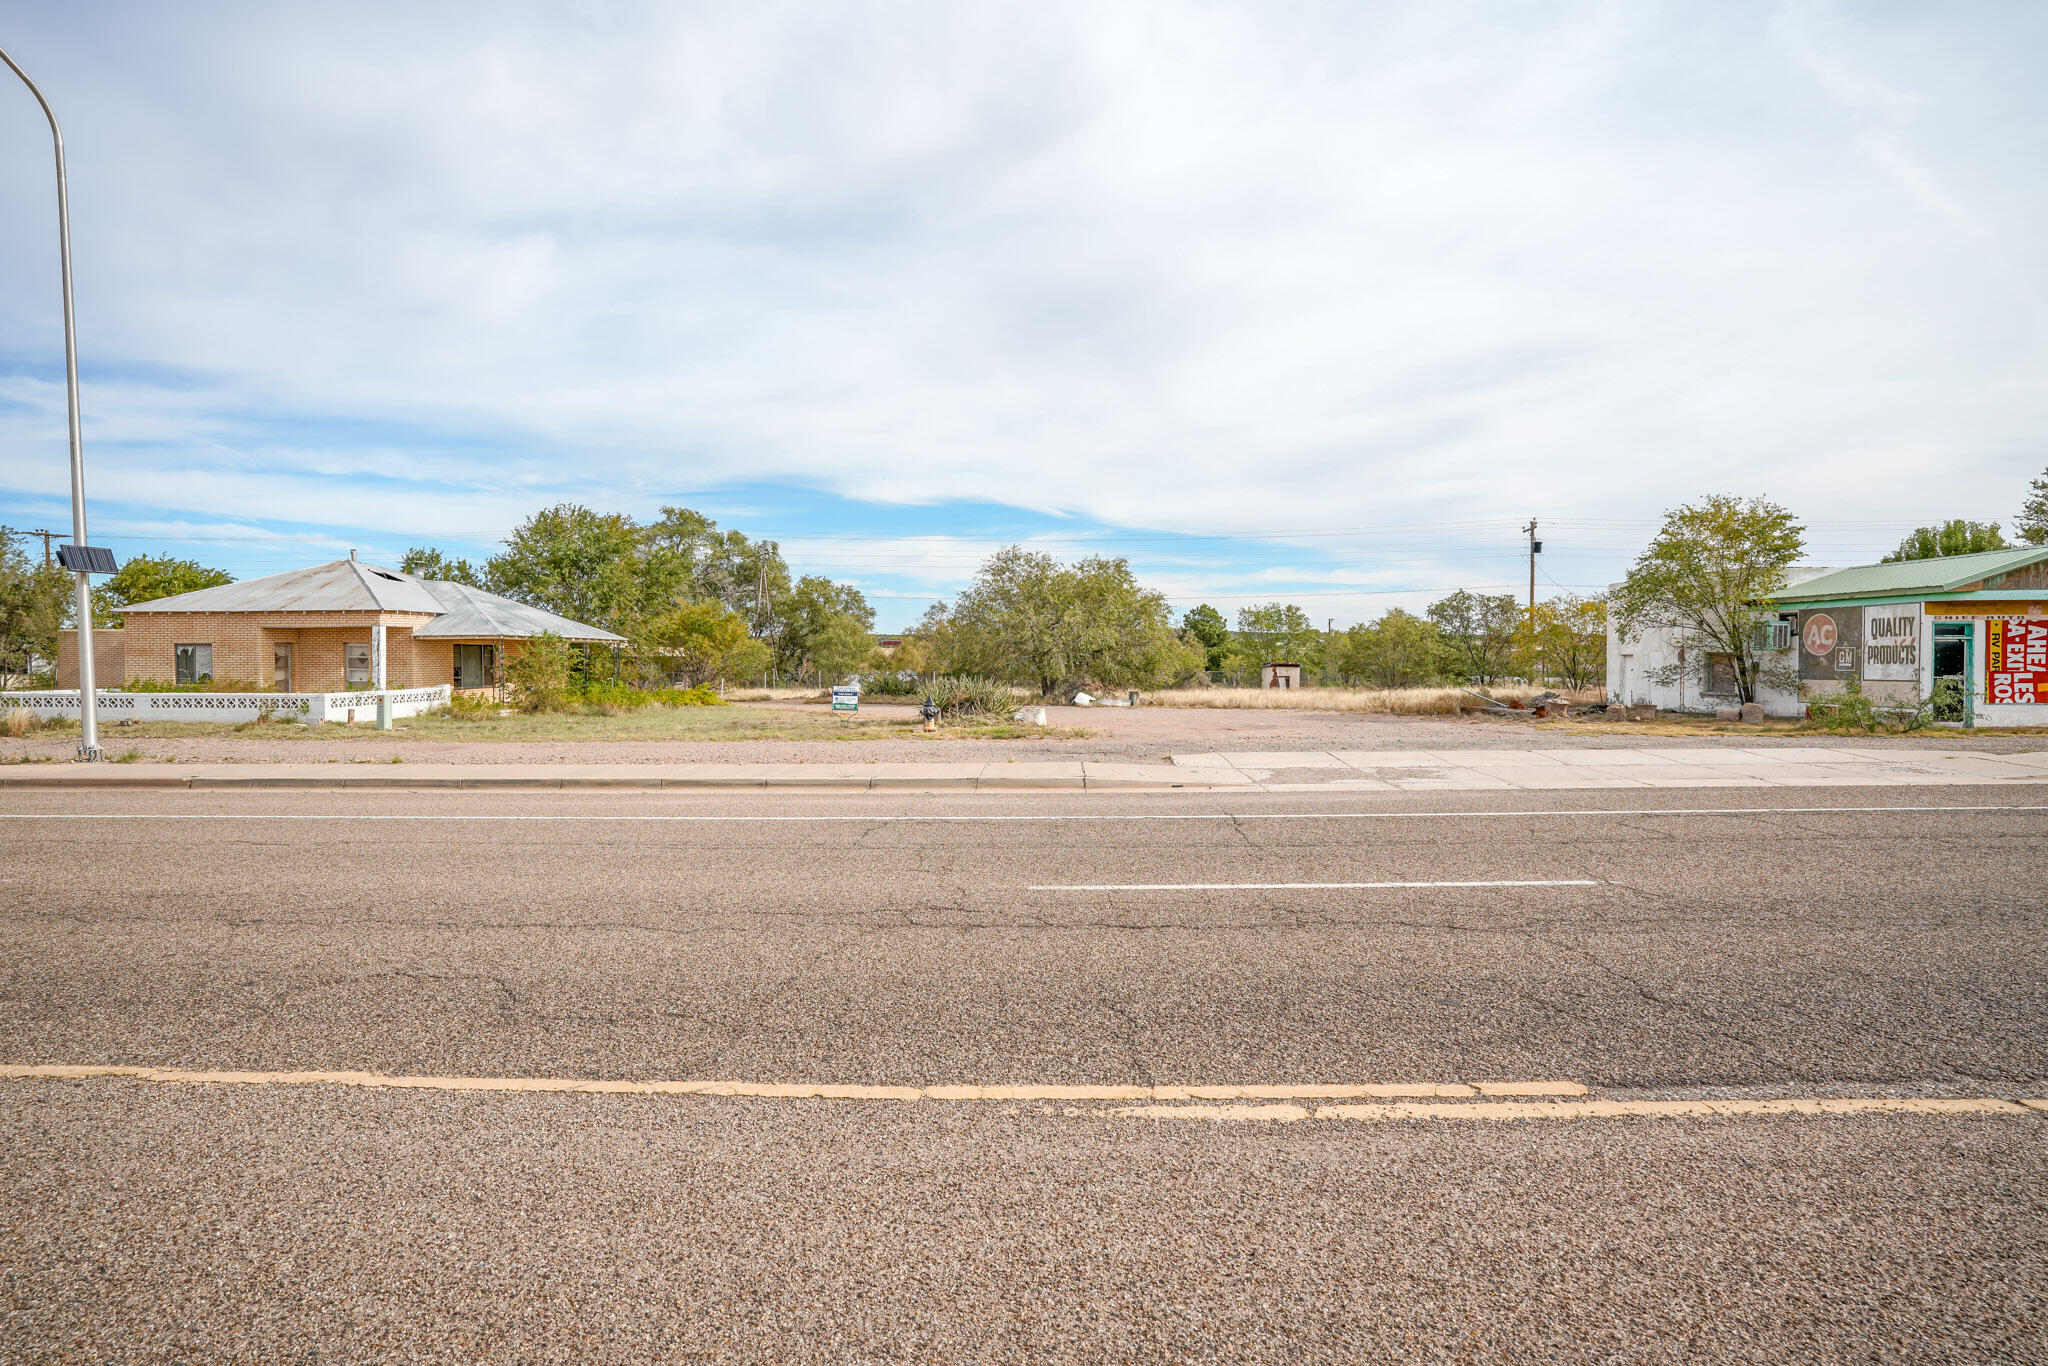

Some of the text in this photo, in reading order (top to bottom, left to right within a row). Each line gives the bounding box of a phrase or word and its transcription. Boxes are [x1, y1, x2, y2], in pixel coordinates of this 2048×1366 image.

[1807, 625, 1833, 645] AC
[1871, 617, 1915, 640] QUALITY
[1992, 633, 2000, 647] RV
[1838, 651, 1853, 664] GM
[1868, 645, 1916, 665] PRODUCTS
